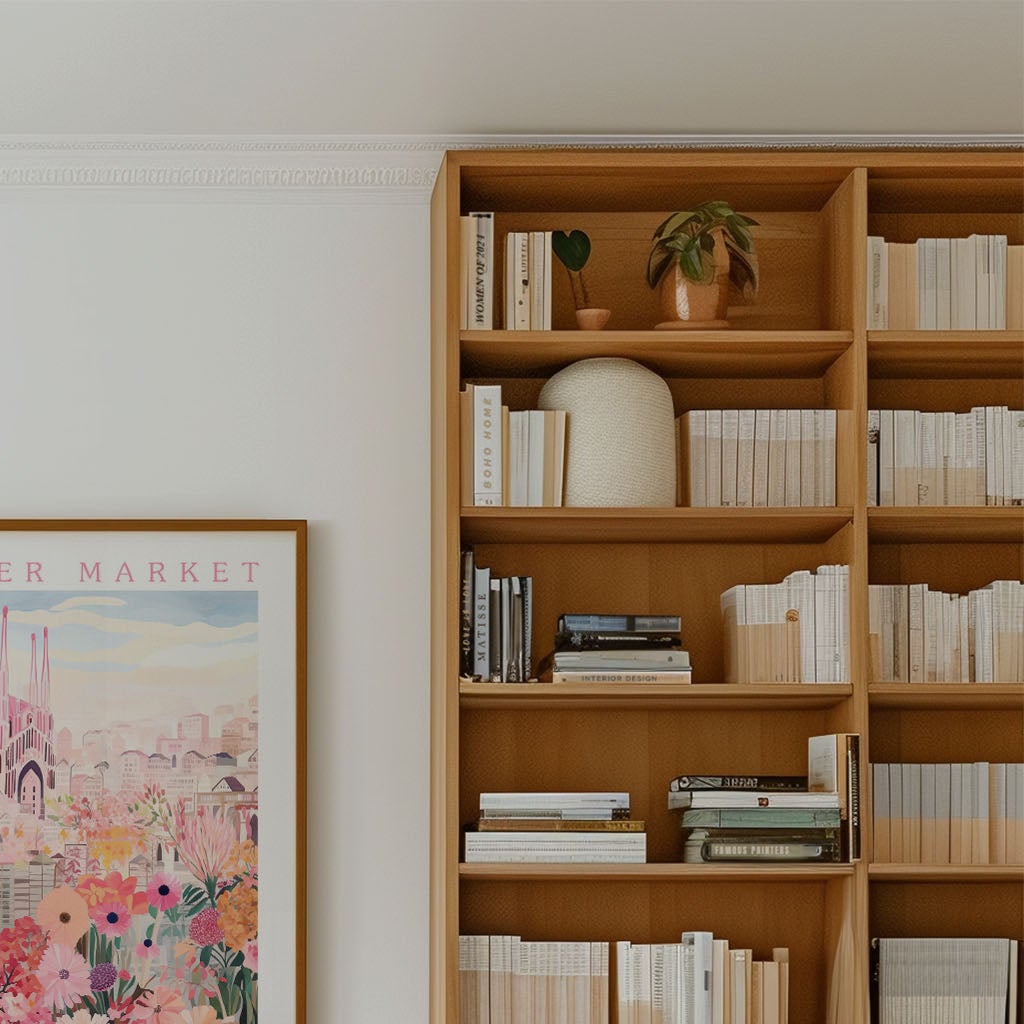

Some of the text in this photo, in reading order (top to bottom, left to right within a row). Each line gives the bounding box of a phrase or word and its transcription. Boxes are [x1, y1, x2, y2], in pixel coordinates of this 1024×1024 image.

[476, 260, 485, 276] OF
[475, 278, 485, 323] WOMEN
[483, 397, 492, 489] BOHO HOME
[79, 561, 261, 583] MARKET
[477, 593, 487, 661] MATISSE
[714, 845, 790, 855] FAMOUS PAINTERS
